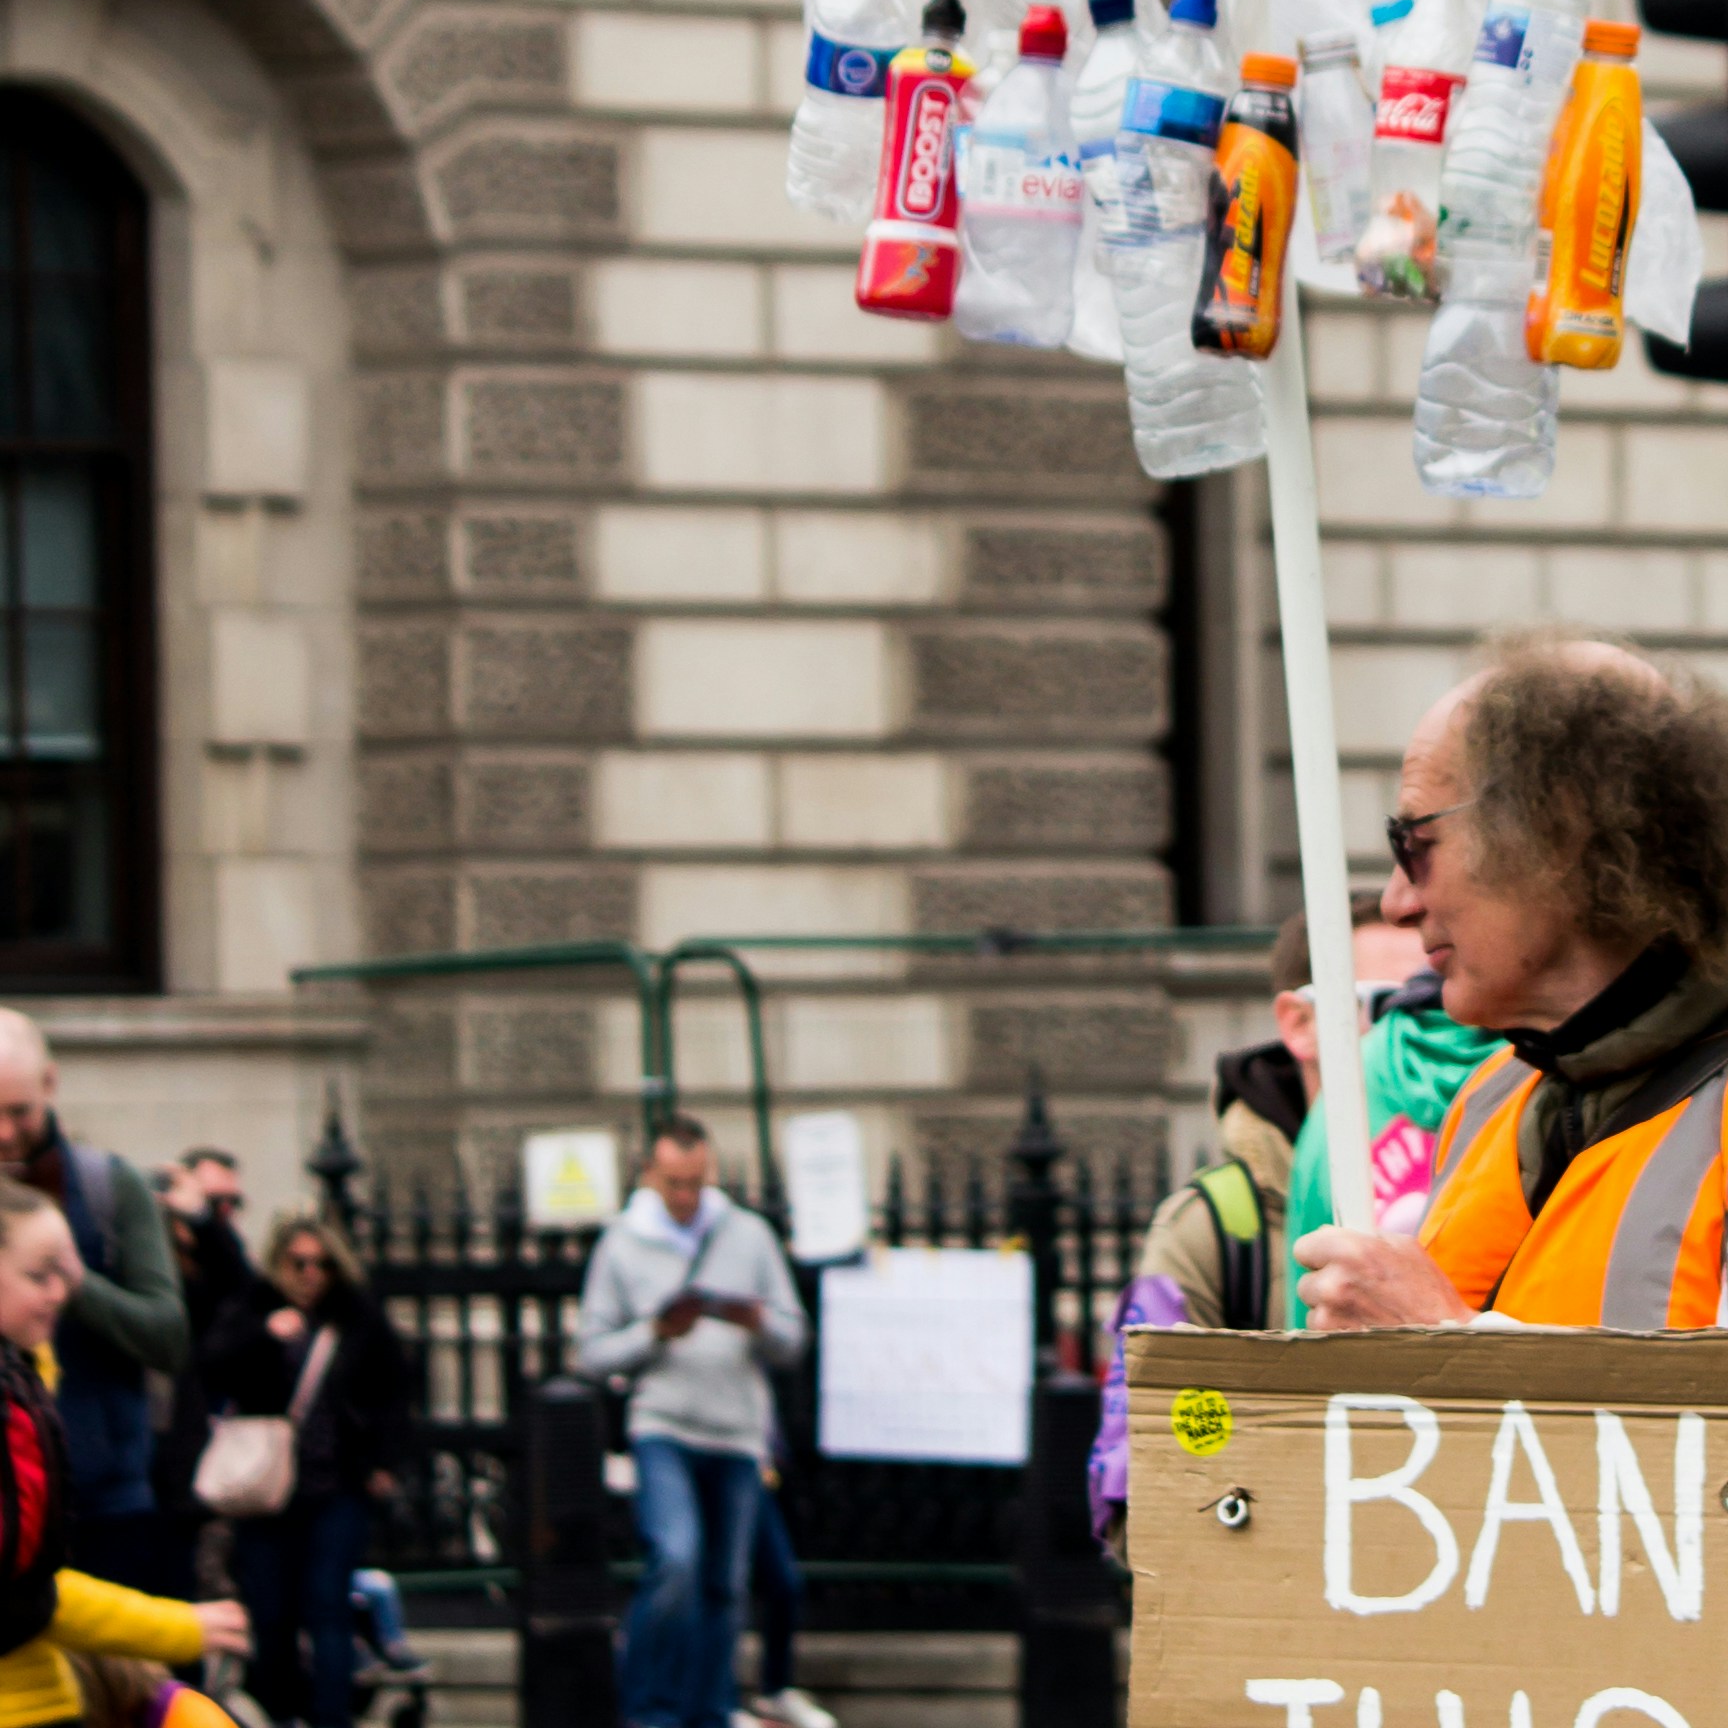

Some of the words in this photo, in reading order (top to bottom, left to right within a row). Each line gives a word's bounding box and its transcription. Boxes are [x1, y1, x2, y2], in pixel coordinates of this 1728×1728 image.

[907, 90, 946, 210] BOOST
[1021, 172, 1083, 201] evia
[1579, 112, 1626, 290] Lucozade
[1322, 1394, 1708, 1623] BAN
